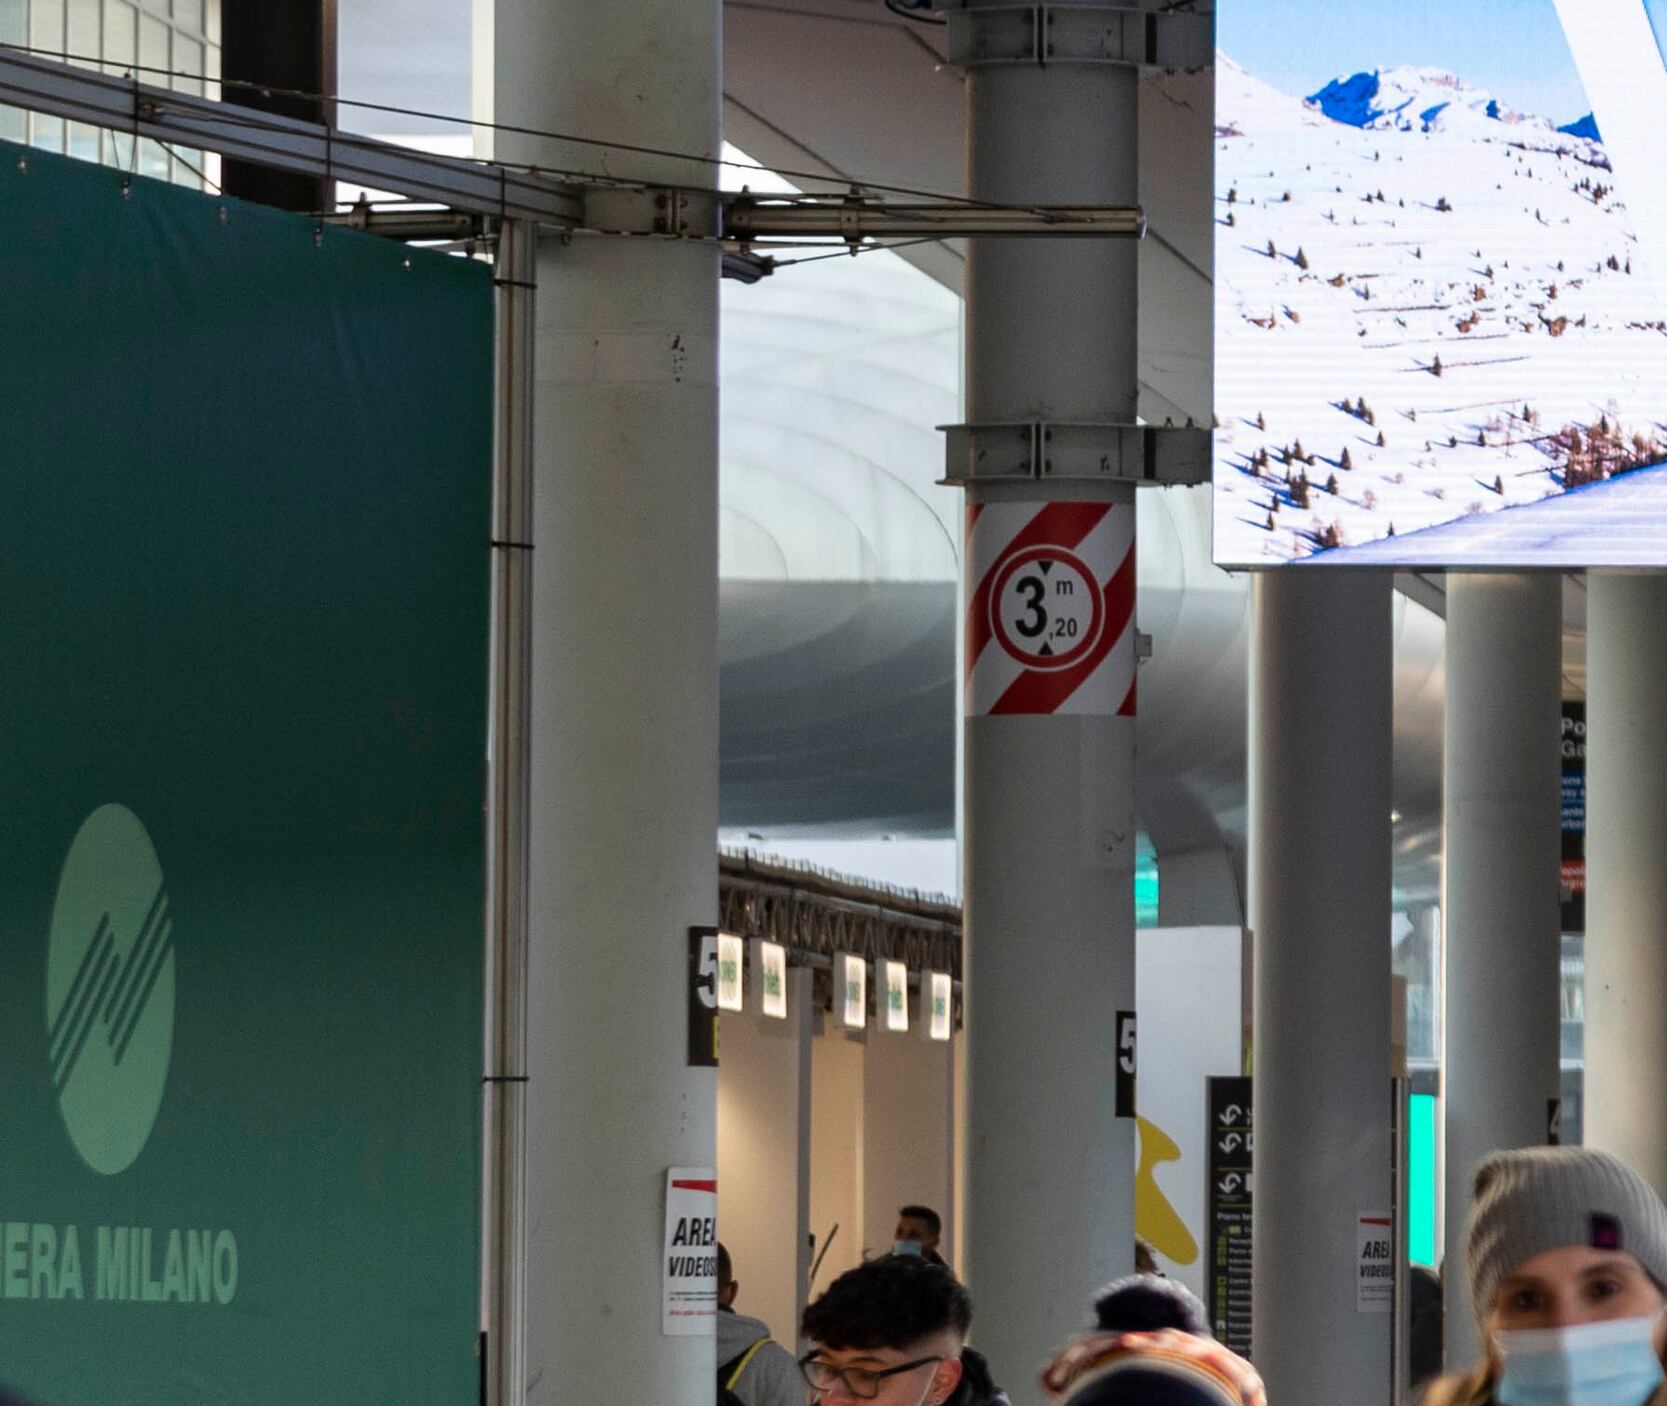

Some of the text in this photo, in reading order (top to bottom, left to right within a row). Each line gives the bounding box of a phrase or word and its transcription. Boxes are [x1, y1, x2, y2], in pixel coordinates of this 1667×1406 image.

[1015, 575, 1073, 637] 3 m
[0, 1222, 239, 1305] ERA MILANO
[669, 1256, 718, 1277] VIDEOS
